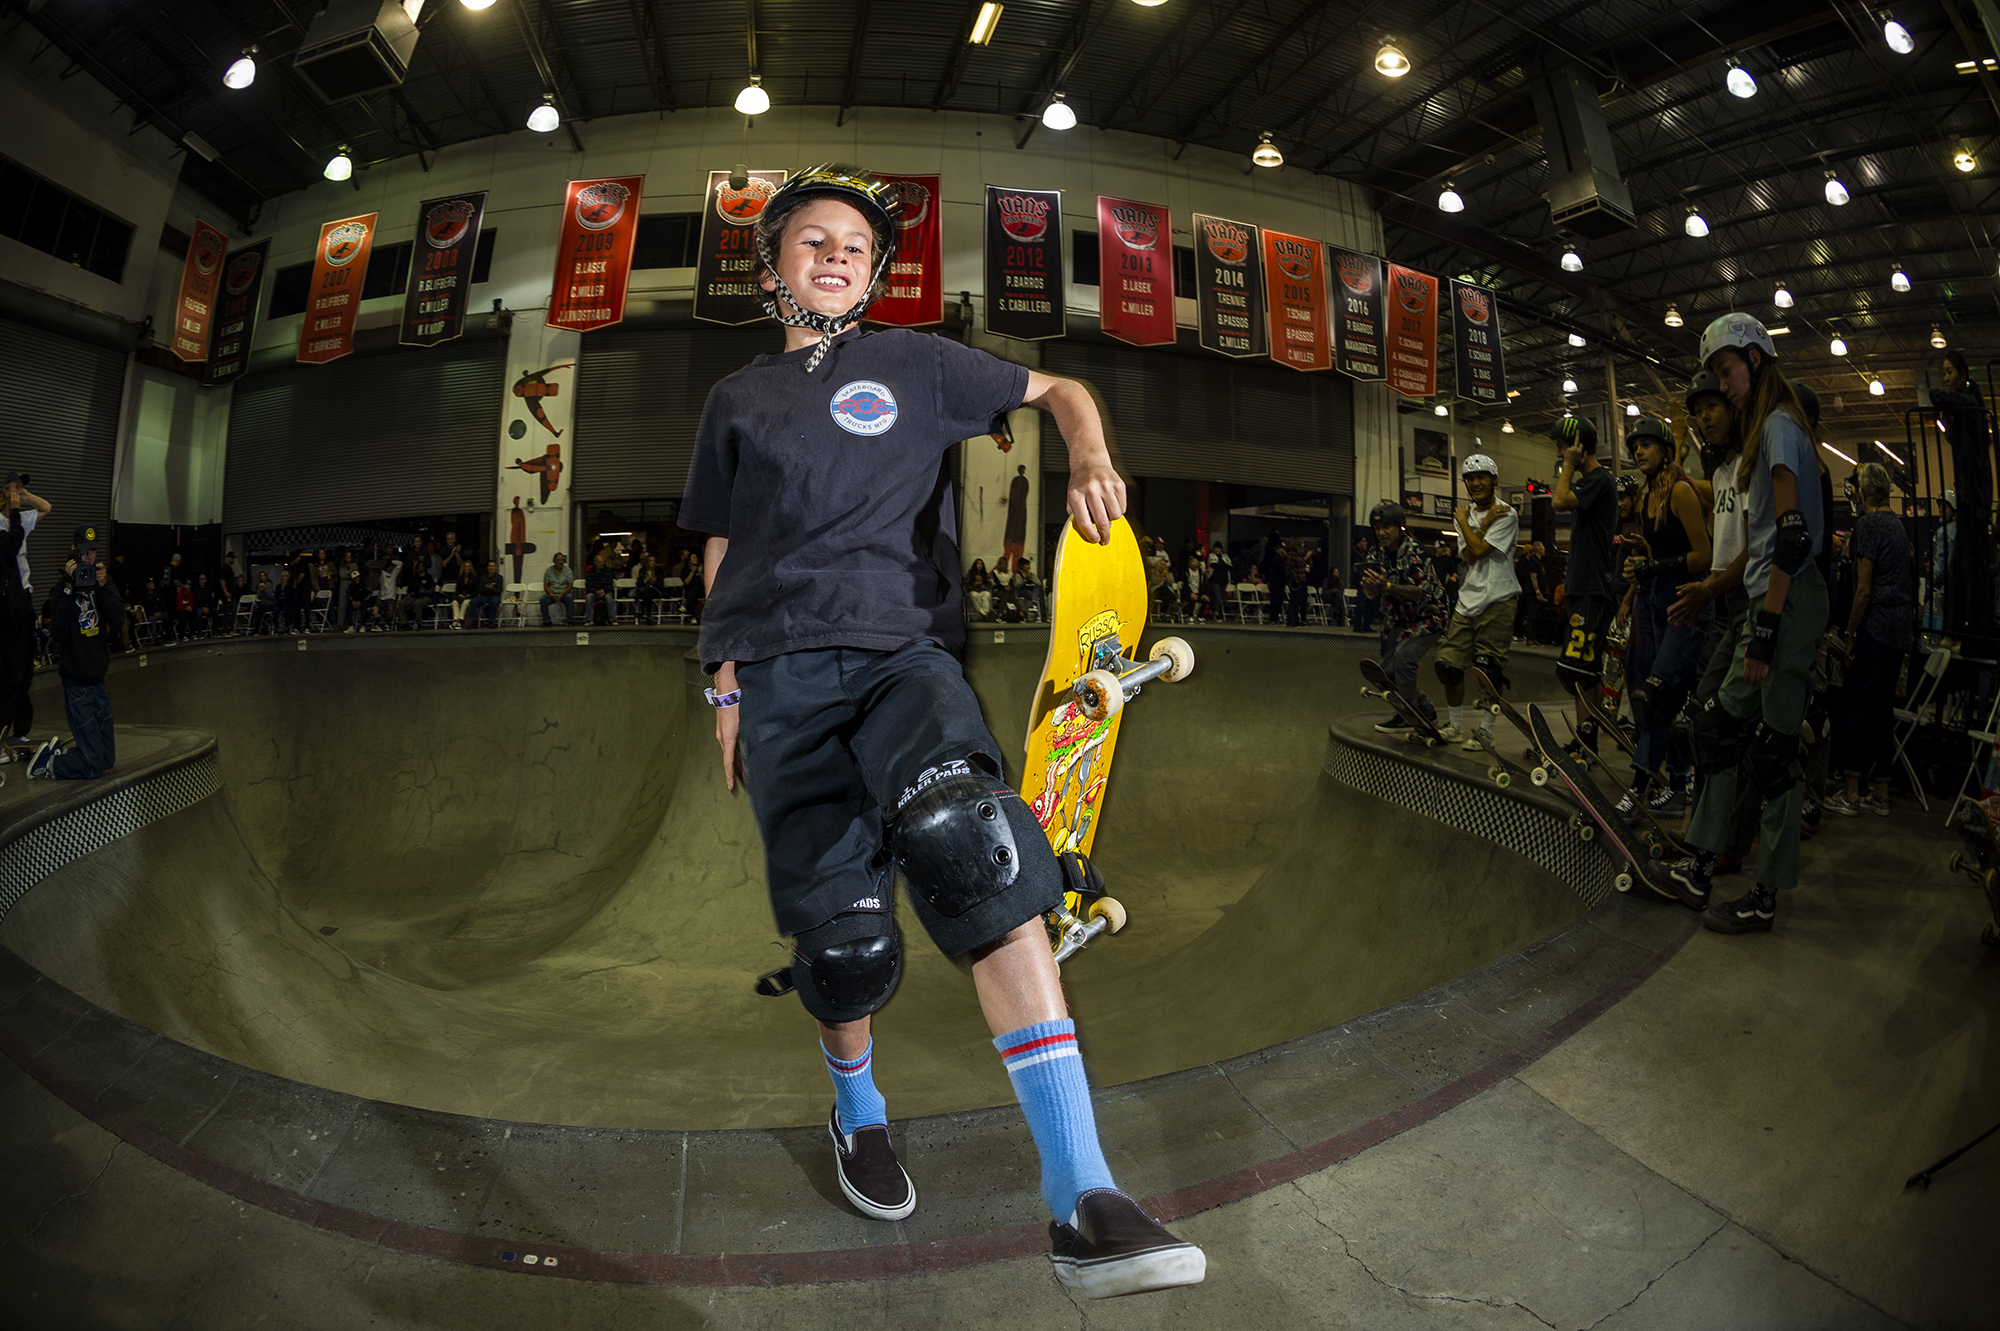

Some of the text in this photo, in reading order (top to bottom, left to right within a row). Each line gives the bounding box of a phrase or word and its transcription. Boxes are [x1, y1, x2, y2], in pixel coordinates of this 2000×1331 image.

[576, 232, 614, 252] 2009
[425, 248, 458, 271] 2008
[1007, 245, 1043, 268] 2012
[1121, 253, 1152, 273] 2013
[575, 261, 607, 275] B.LASEK
[888, 263, 923, 275] .BARROS
[322, 268, 351, 288] 2007
[1005, 275, 1045, 289] P.BARROS
[1215, 268, 1245, 288] 2014
[570, 285, 605, 298] C.MILLER
[1122, 279, 1152, 294] B.LASEK
[1284, 284, 1310, 302] 2015
[419, 298, 450, 314] C.MILLER
[1121, 301, 1154, 316] C.MILLER
[1347, 297, 1369, 316] 2016
[314, 316, 342, 331] C.MILLER
[1217, 314, 1249, 329] B.PASSOS
[1402, 317, 1421, 334] 2017
[1219, 335, 1250, 350] C.MILLER
[1286, 328, 1314, 343] B.PASSOS
[1468, 328, 1487, 345] 2018
[1287, 349, 1315, 364] C.MILLER
[841, 385, 886, 397] SKATEBOARD
[843, 417, 887, 430] TRUCKS MFG
[1565, 629, 1597, 662] 23
[898, 767, 971, 809] KILLER PADS
